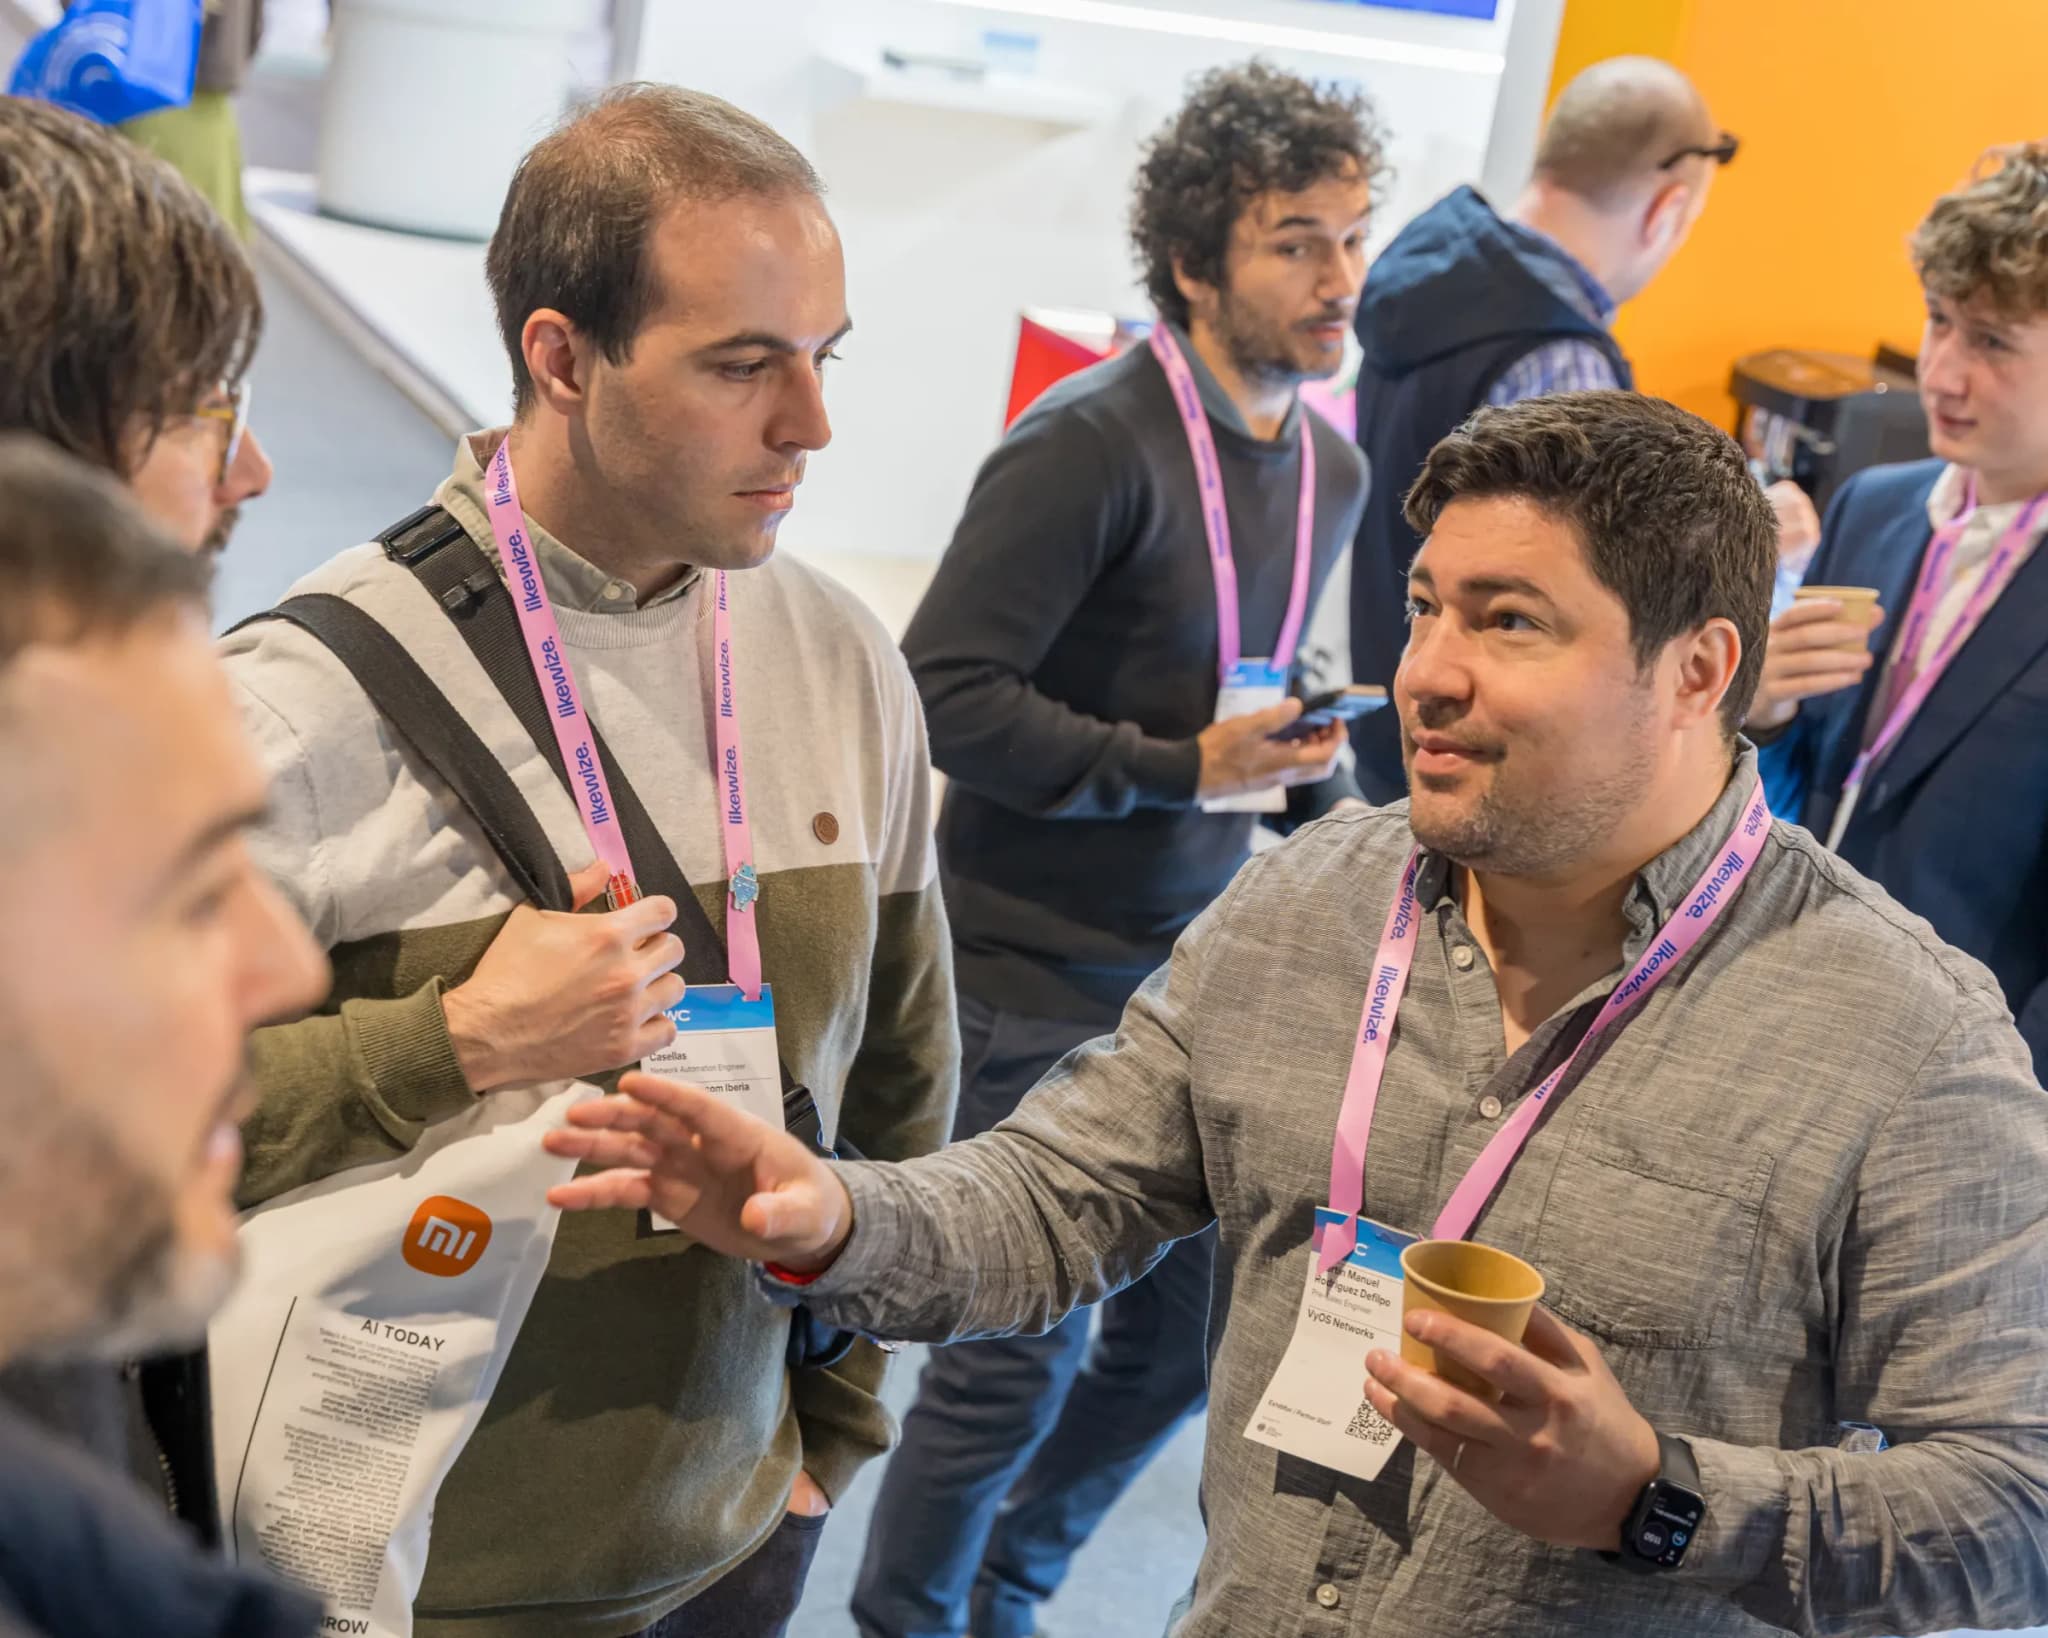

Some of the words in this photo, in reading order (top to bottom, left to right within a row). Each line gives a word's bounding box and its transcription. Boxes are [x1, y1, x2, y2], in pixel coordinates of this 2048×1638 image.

[508, 529, 543, 612] likewize.
[544, 636, 577, 718] likewize.
[719, 638, 733, 717] likewize.
[576, 741, 610, 824] likewize.
[724, 745, 743, 824] likewize.
[1685, 851, 1745, 919] likewize.
[1363, 965, 1399, 1044] likewize.
[360, 1319, 379, 1335] AI
[384, 1324, 445, 1351] TODAY
[1332, 1317, 1375, 1340] Networks
